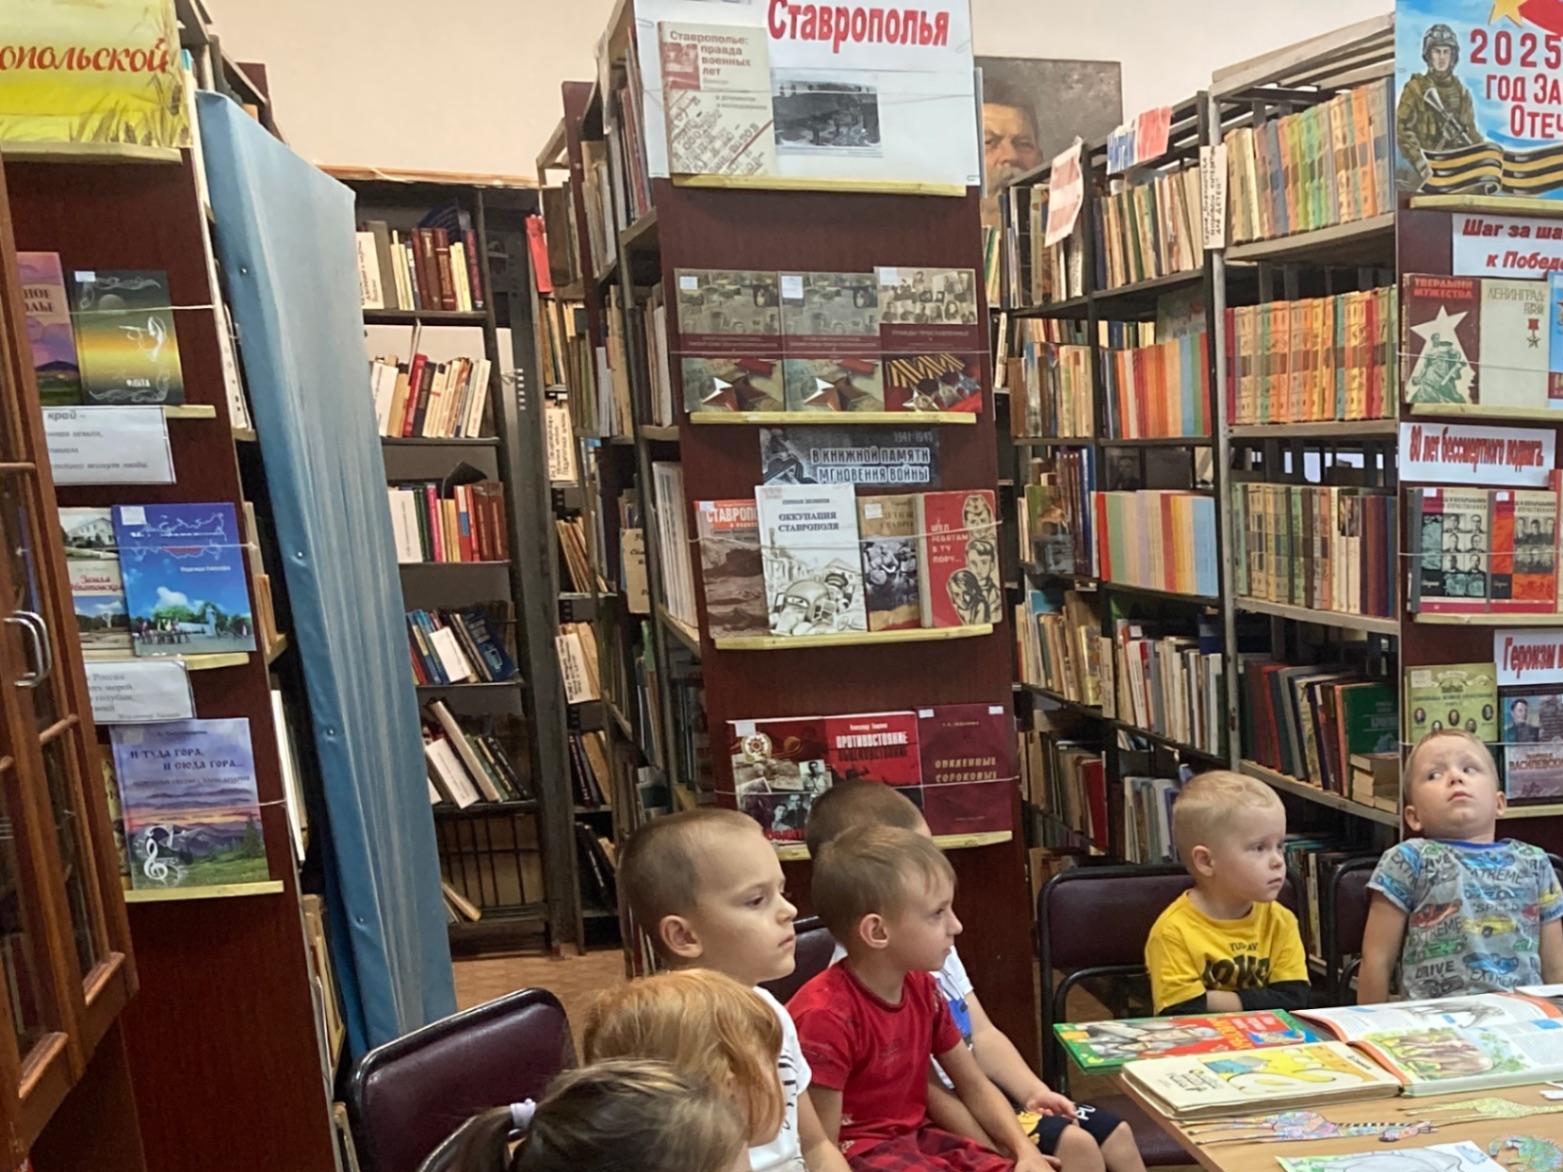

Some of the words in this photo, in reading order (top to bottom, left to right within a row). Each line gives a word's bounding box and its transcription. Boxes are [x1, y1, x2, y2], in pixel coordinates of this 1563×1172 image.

[768, 0, 949, 53] Ставрополья
[1469, 29, 1561, 69] 2025
[1463, 219, 1502, 237] Шаг
[1508, 225, 1529, 237] за
[1487, 254, 1498, 267] к
[812, 449, 818, 463] В
[823, 446, 878, 463] КНИЖНОЙ
[881, 449, 930, 463] ПАМЯТИ
[819, 467, 886, 482] МГНОВЕНИЯ
[889, 464, 929, 482] ВОЙНЫ
[706, 507, 757, 522] СТАВРОП
[836, 731, 909, 749] ПРОТИВОСТОЯНИЕ
